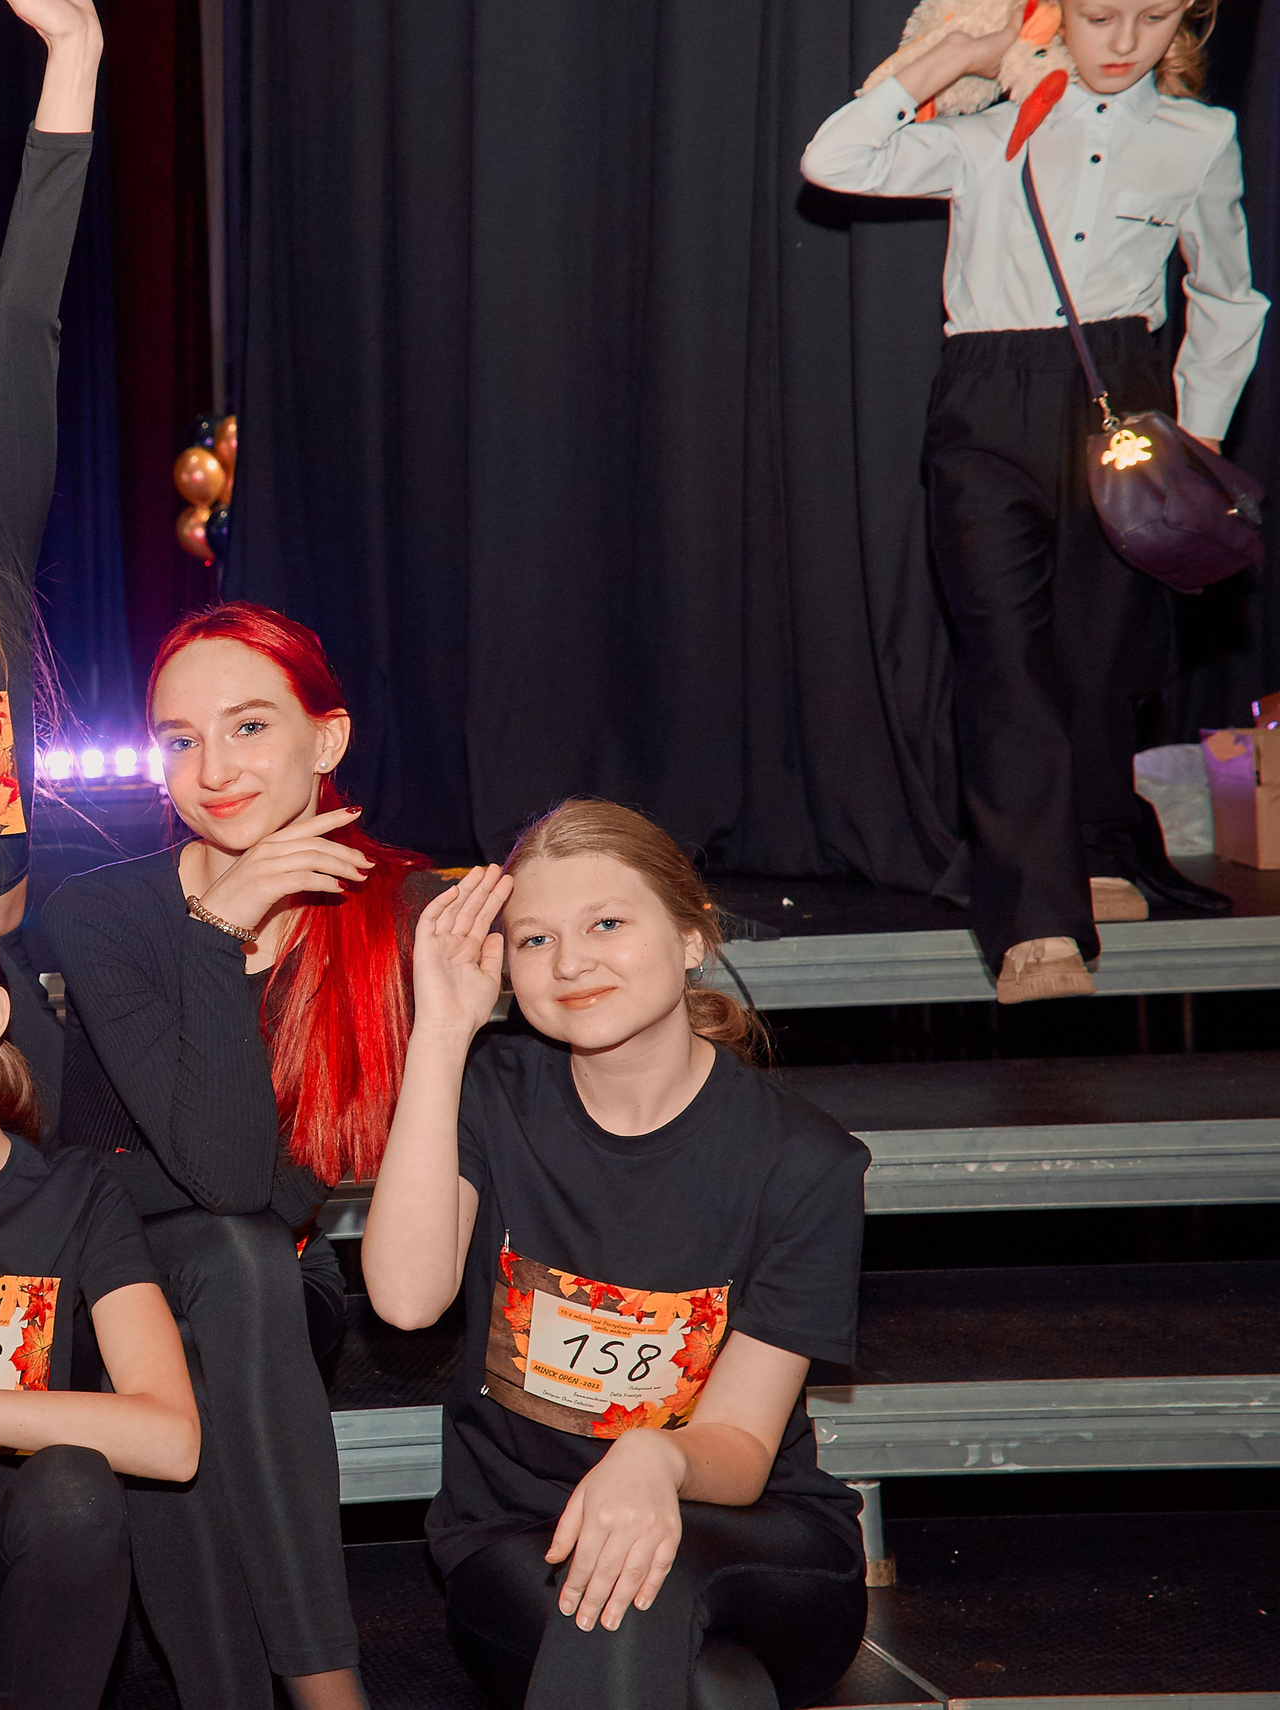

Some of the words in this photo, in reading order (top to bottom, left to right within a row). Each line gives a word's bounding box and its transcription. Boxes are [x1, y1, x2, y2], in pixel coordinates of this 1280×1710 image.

[563, 1334, 662, 1382] 158
[533, 1364, 558, 1378] MINSK
[558, 1374, 579, 1384] OPEN
[580, 1381, 600, 1389] -2022
